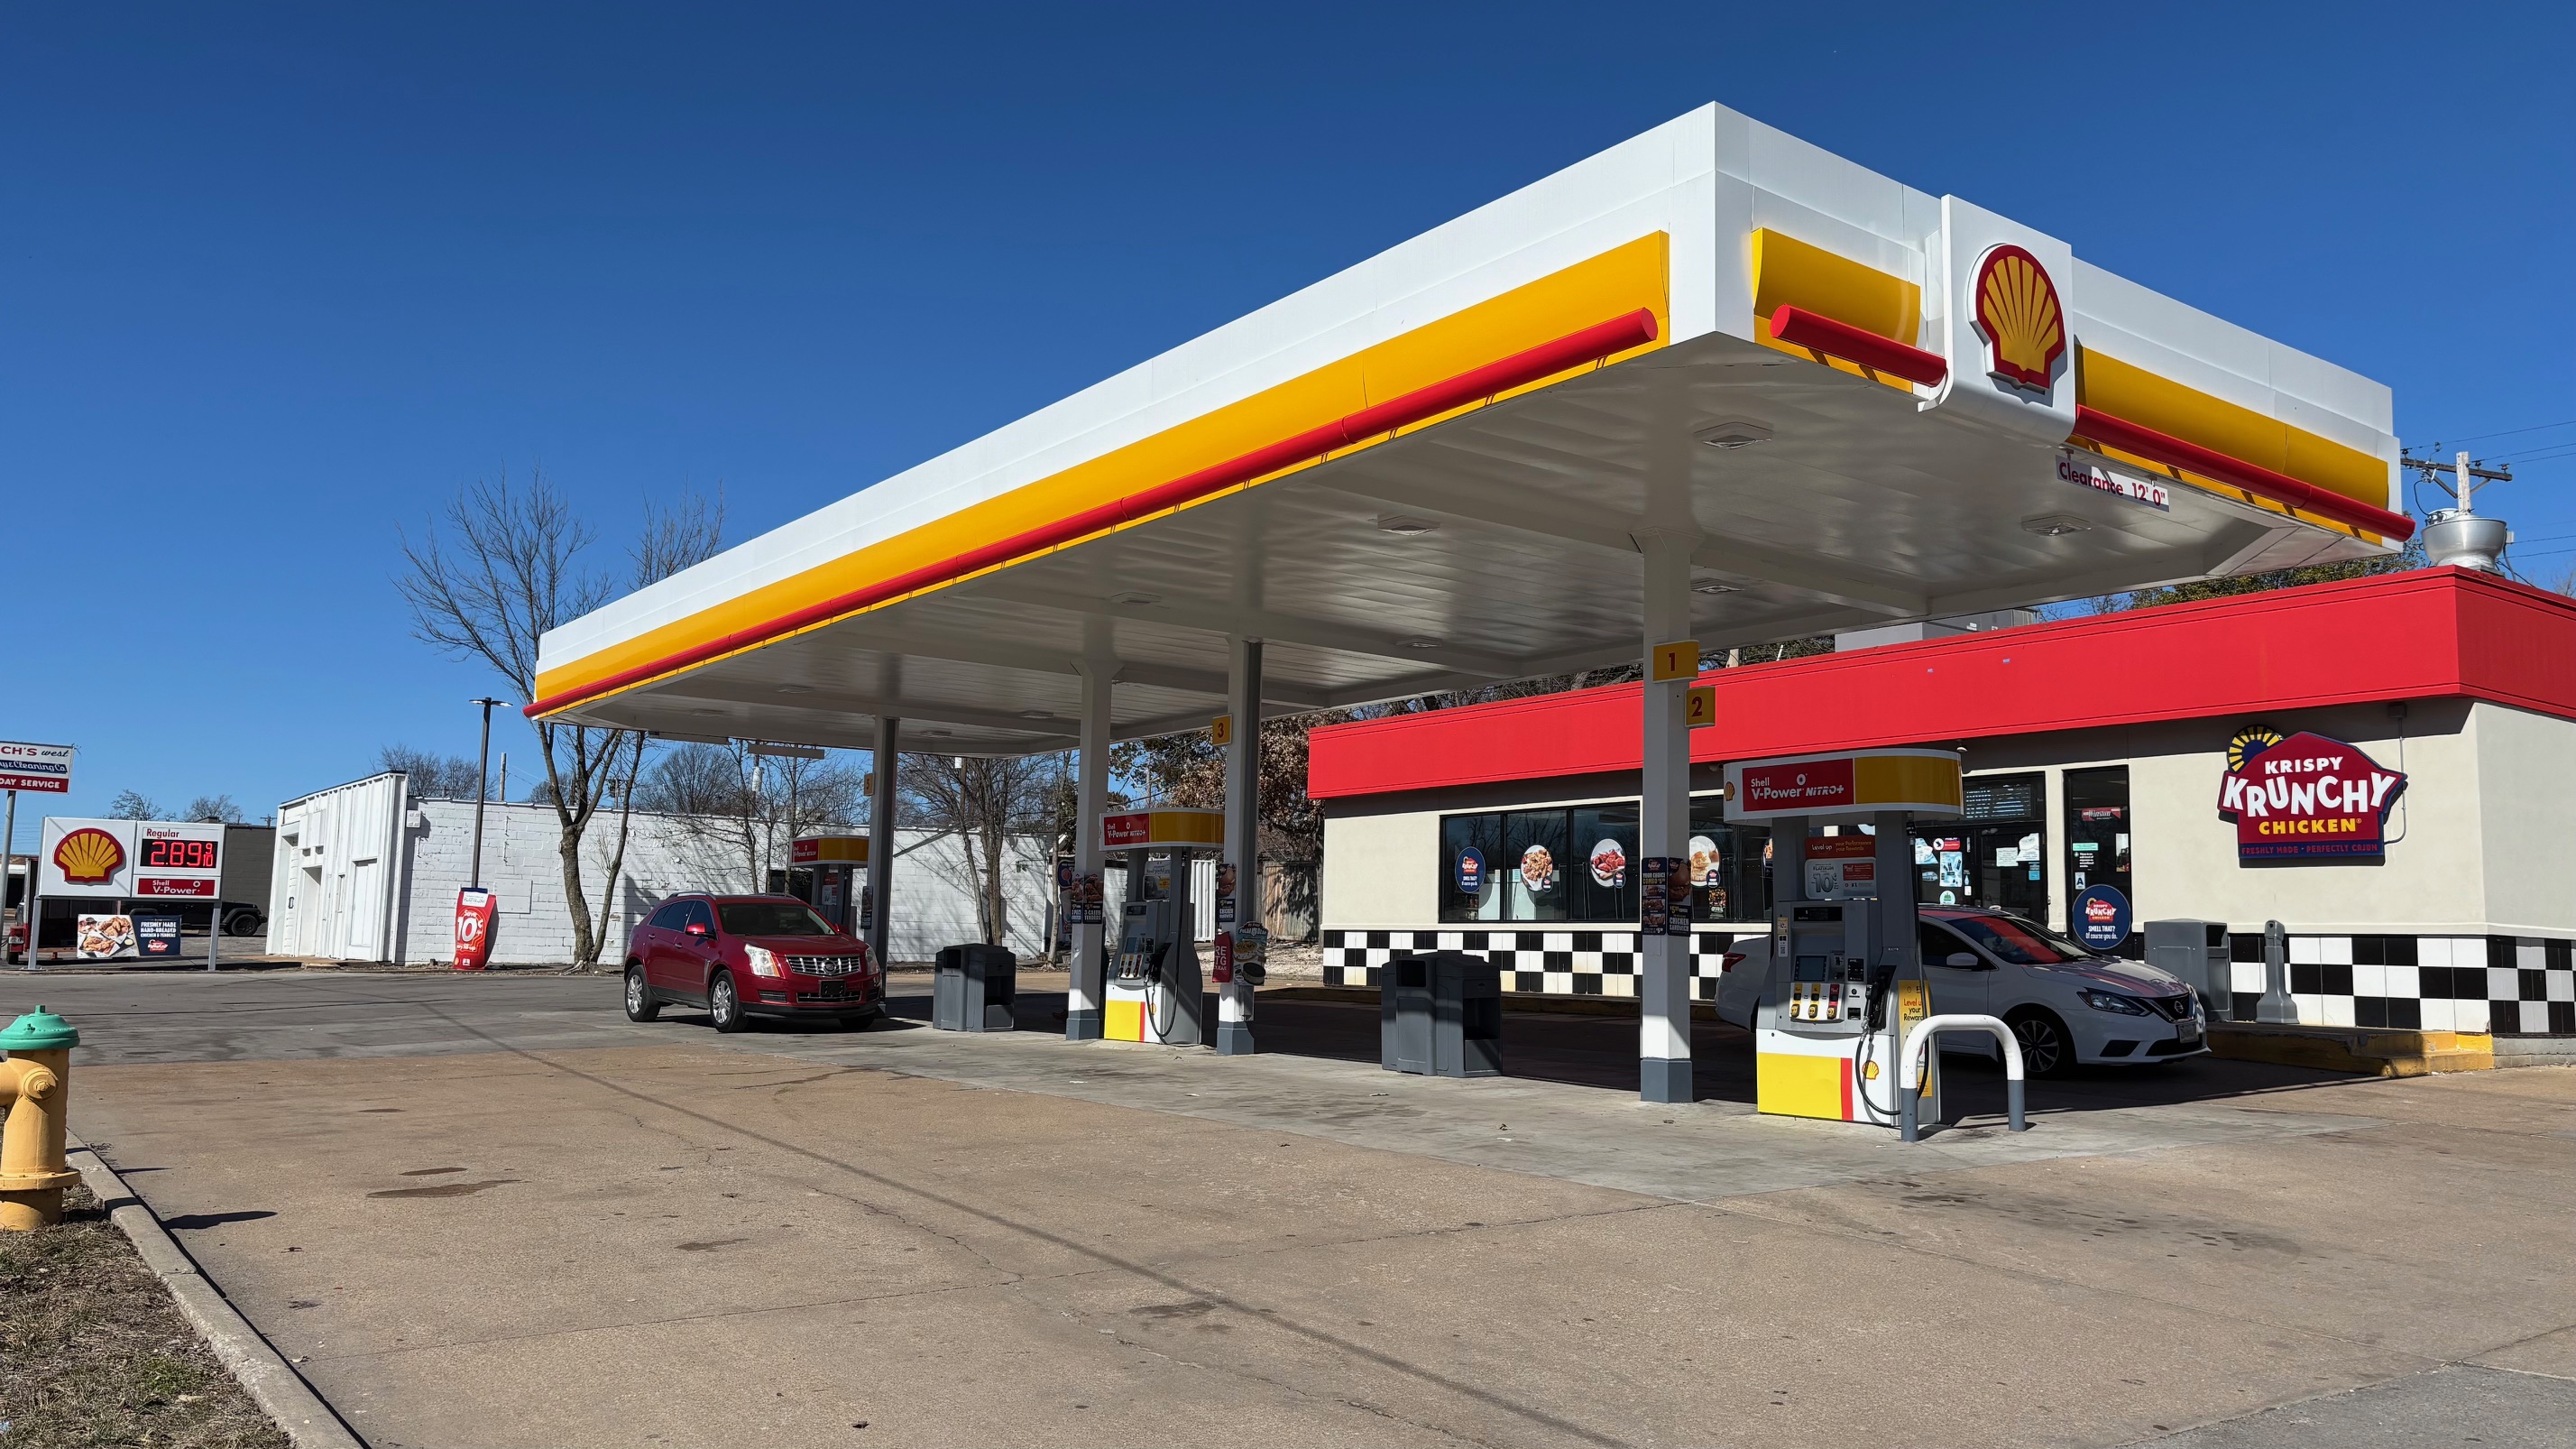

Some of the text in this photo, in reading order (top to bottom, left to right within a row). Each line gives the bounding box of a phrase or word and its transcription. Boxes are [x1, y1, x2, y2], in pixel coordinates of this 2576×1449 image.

[2058, 461, 2124, 496] Clearance
[1669, 652, 1676, 672] 1
[1691, 696, 1703, 717] 2
[1218, 722, 1224, 739] 3
[0, 745, 69, 758] CH'S west
[2265, 756, 2343, 775] KRISPY
[21, 779, 60, 789] SERVICE
[1751, 777, 1770, 788] Shell
[1751, 787, 1802, 800] V-Power
[2222, 771, 2397, 817] KRUNCHY
[146, 827, 180, 839] Regular
[150, 841, 203, 866] 2.89
[2241, 844, 2378, 855] FRESHLY MADE PERFECTLY CAJUN
[2076, 877, 2084, 885] A
[152, 886, 198, 894] V-Power
[2084, 907, 2117, 917] KRUNCHY
[1903, 998, 1918, 1006] Level
[1909, 1007, 1921, 1016] your
